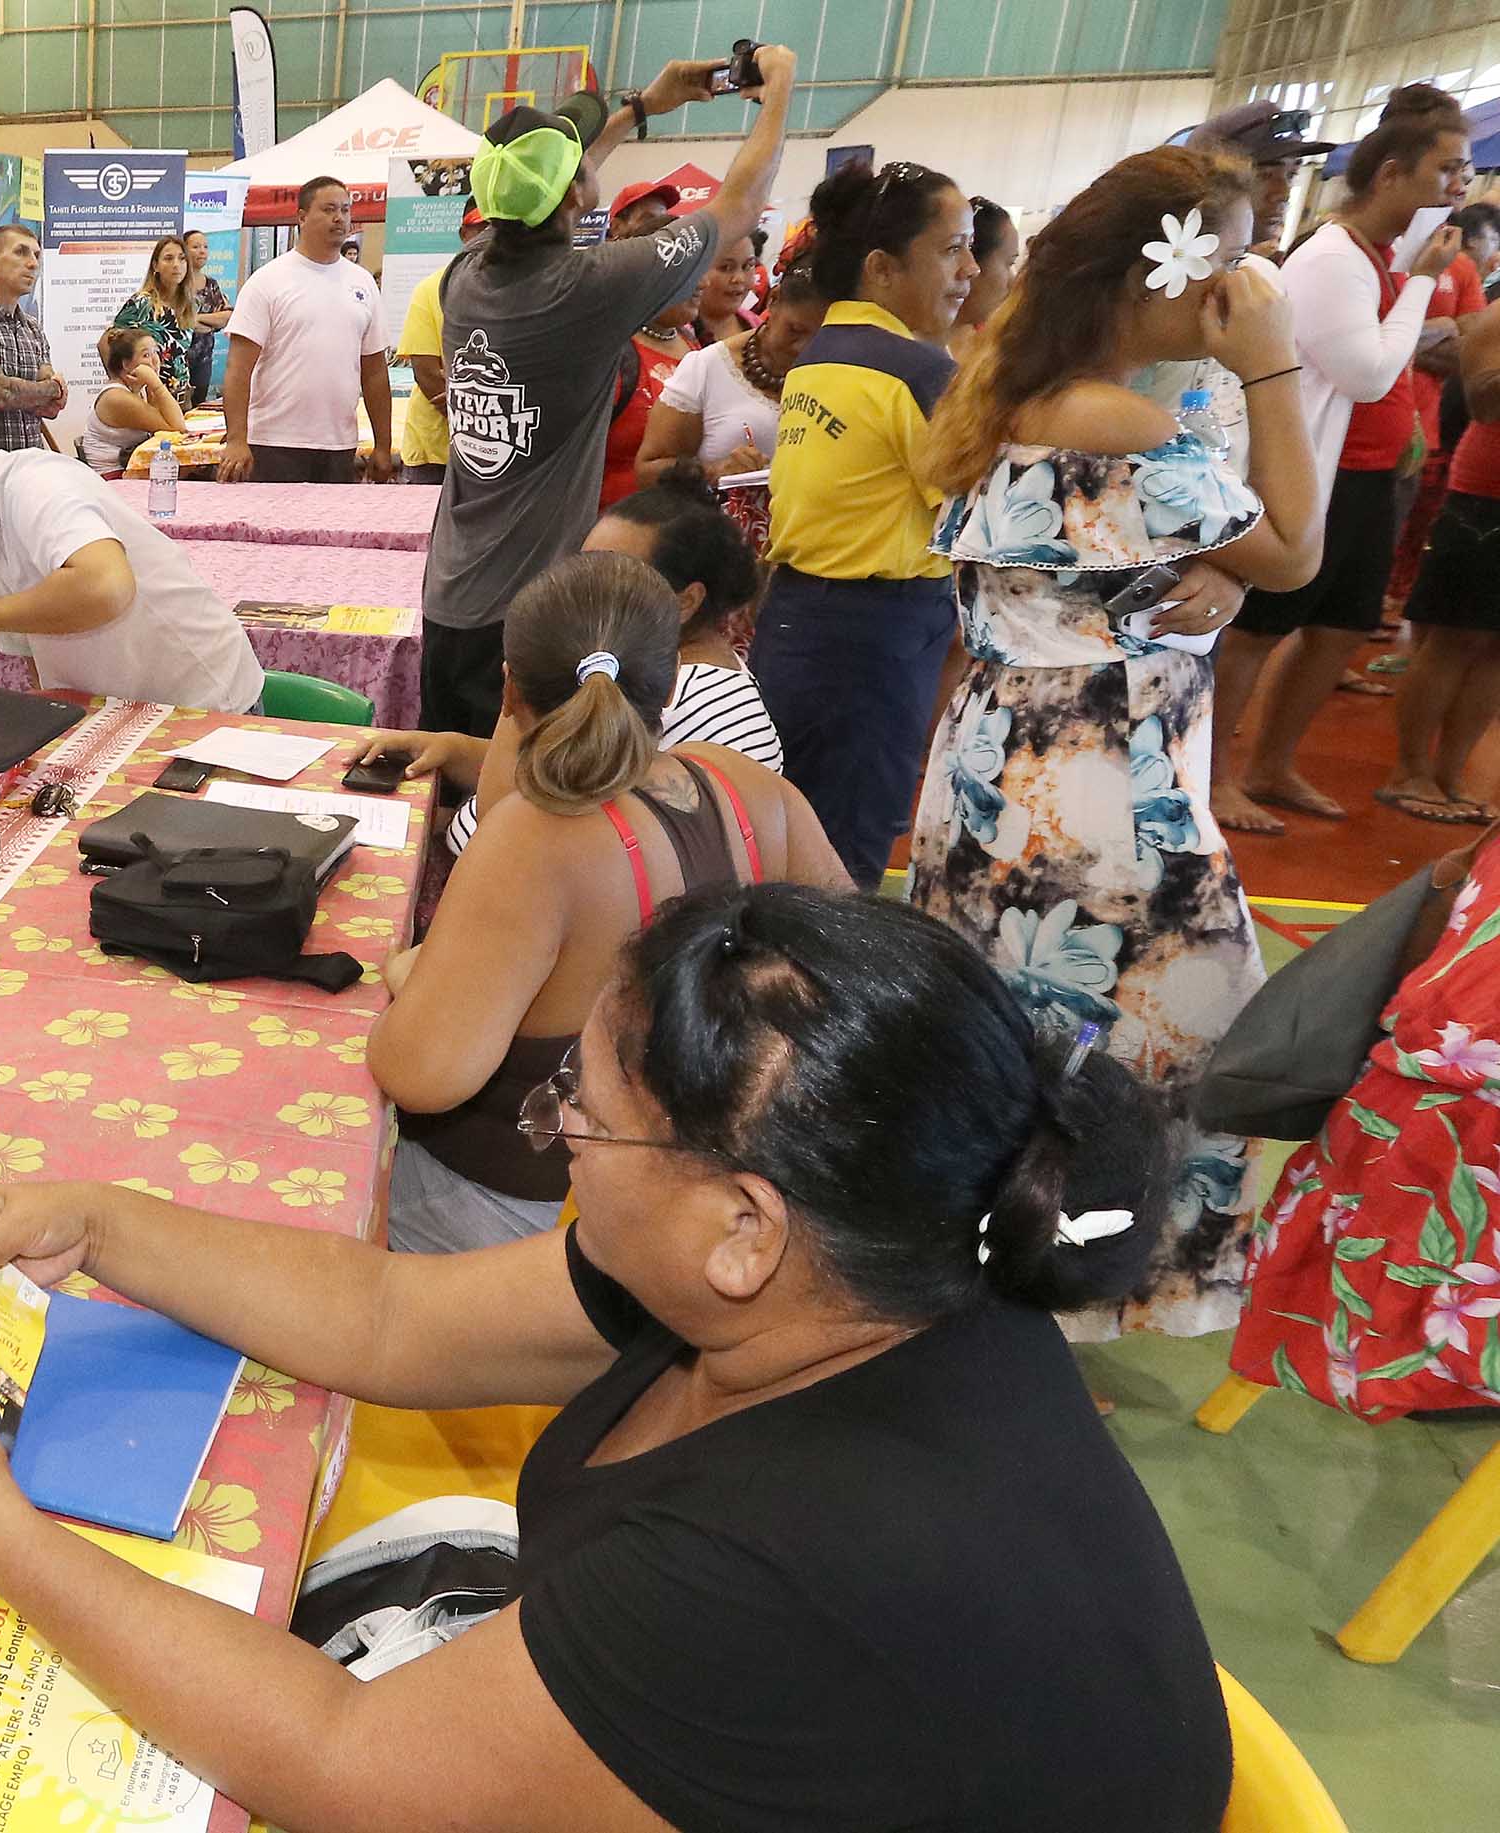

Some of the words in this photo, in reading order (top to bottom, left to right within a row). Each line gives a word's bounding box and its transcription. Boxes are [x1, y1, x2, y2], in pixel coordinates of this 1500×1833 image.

[334, 124, 424, 151] ACE
[454, 388, 504, 416] TEVA
[781, 392, 848, 440] OURISTE
[448, 408, 535, 449] MPORT
[4, 1614, 29, 1670] Leontief
[20, 1648, 46, 1692] STANDS
[11, 1745, 33, 1792] EMPLOI
[28, 1695, 50, 1728] SPEED
[41, 1651, 64, 1693] EMPLO
[127, 1761, 141, 1795] journée
